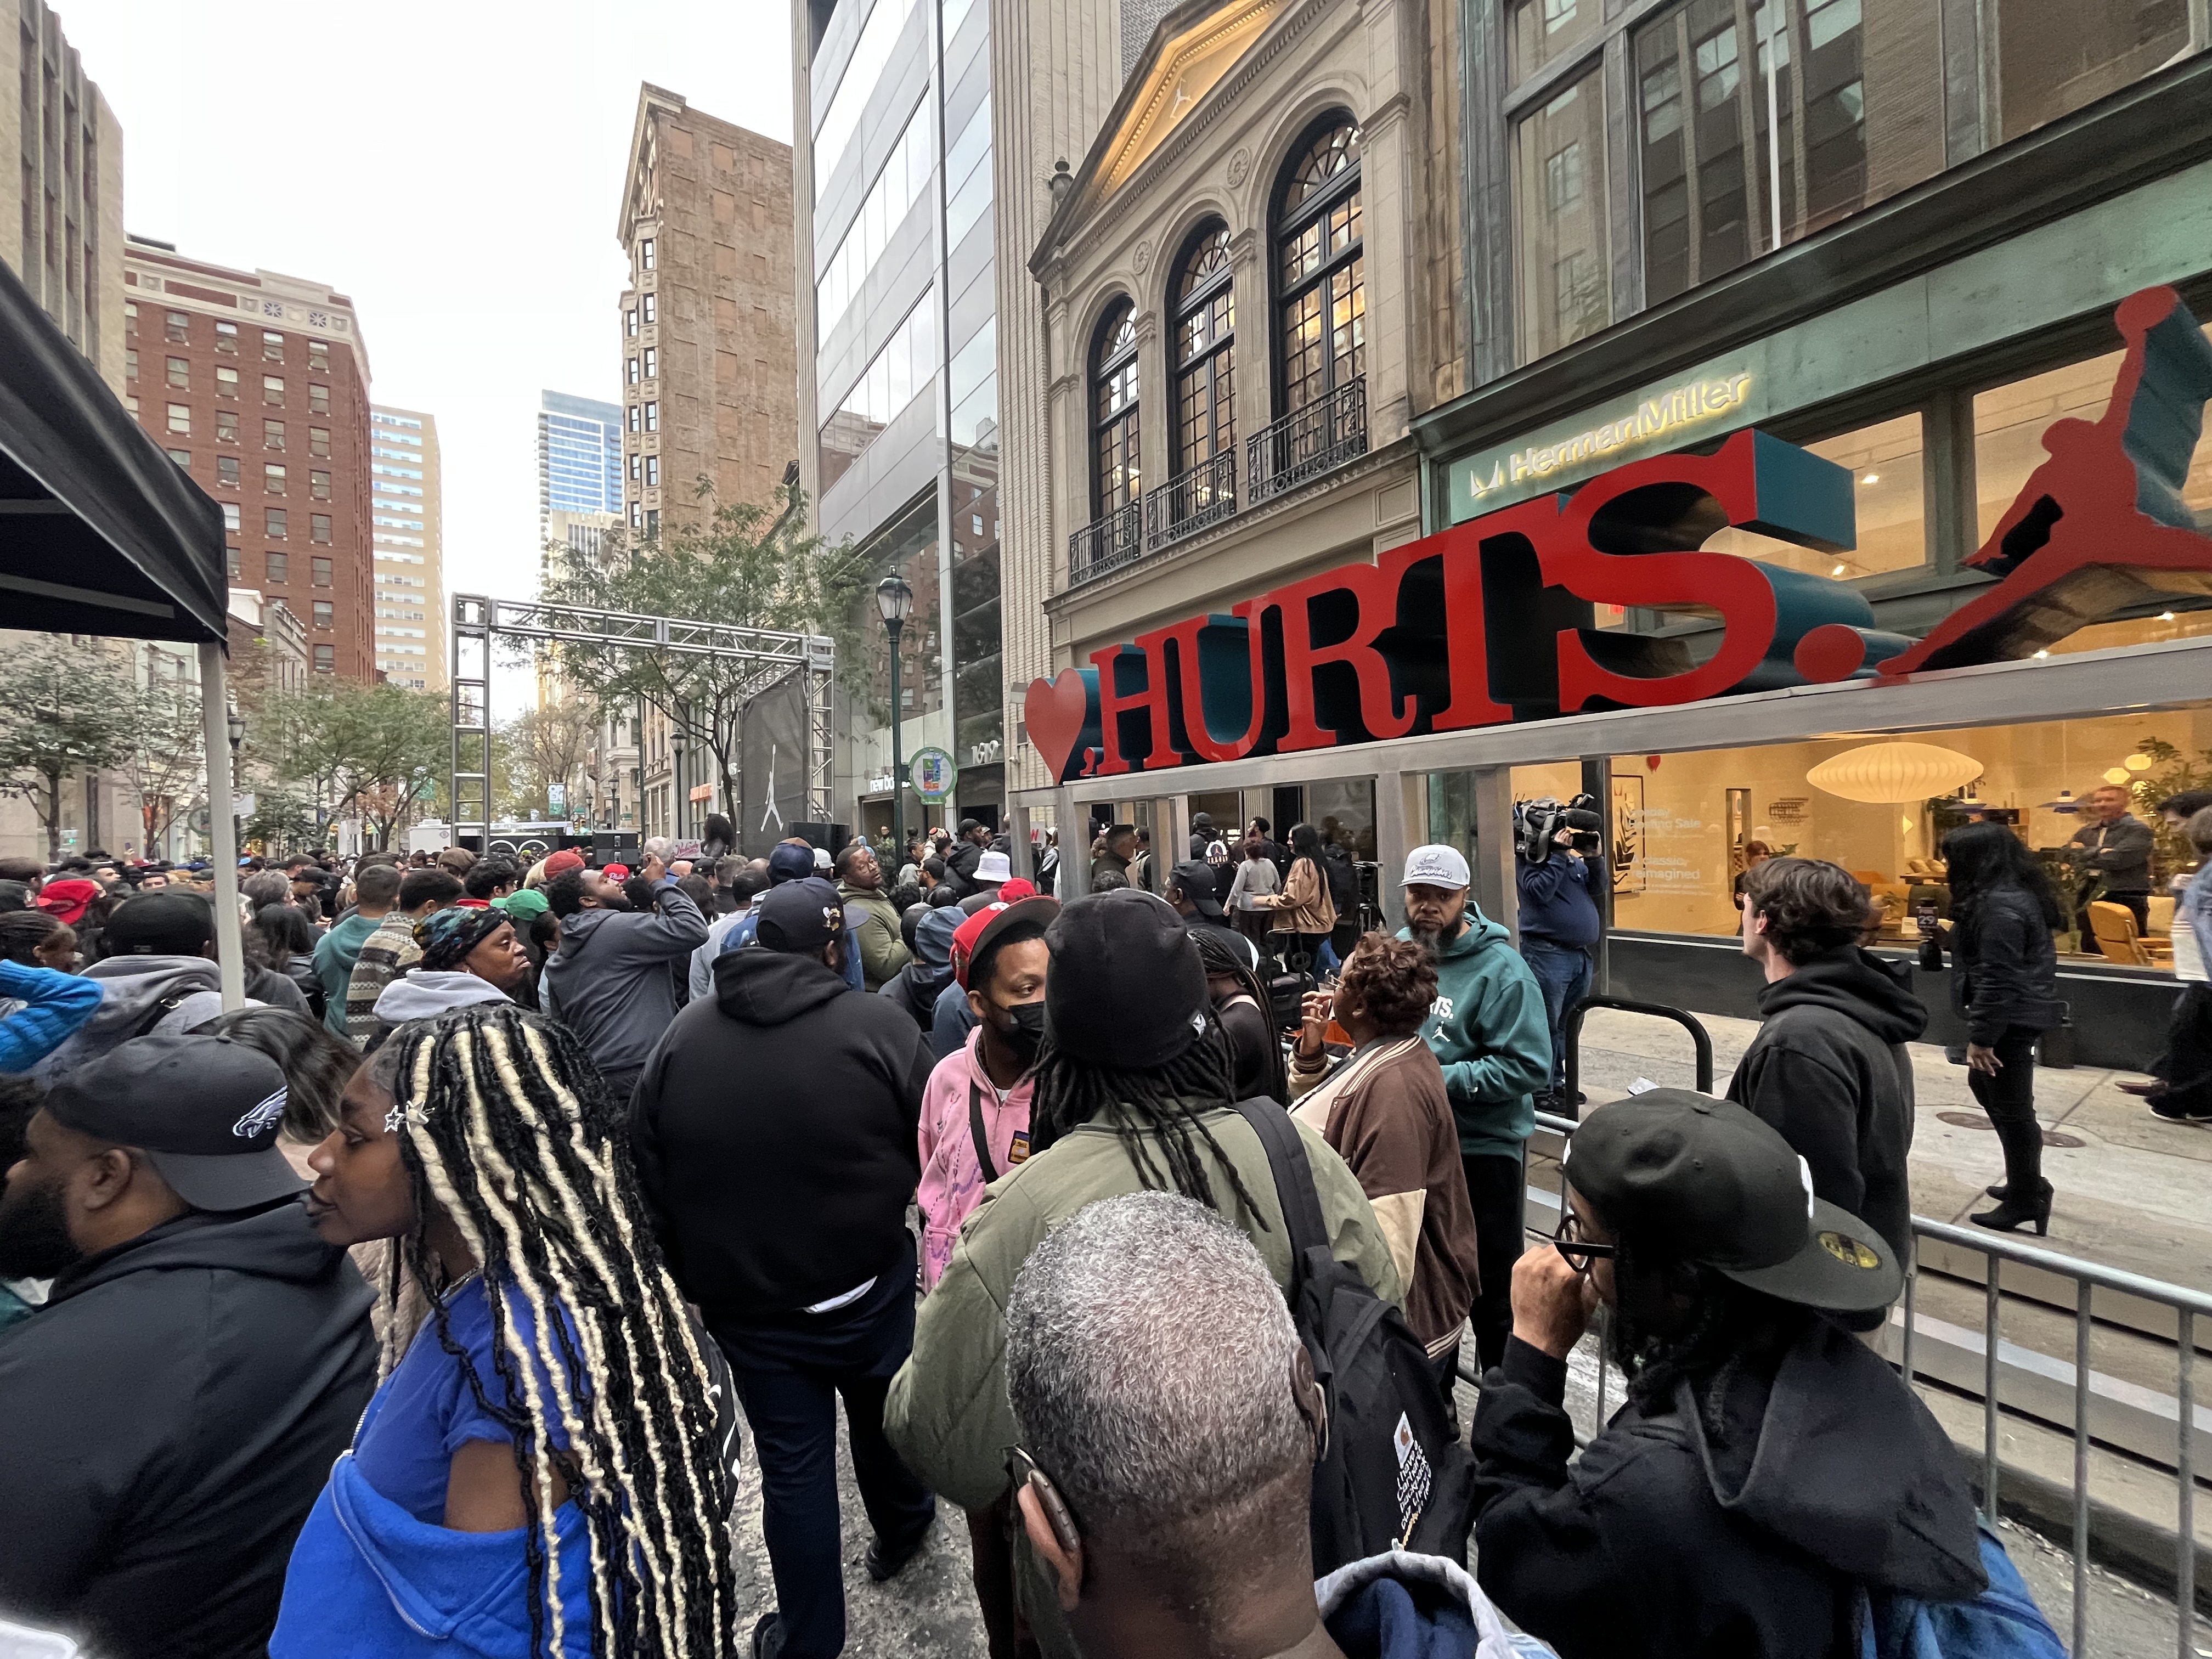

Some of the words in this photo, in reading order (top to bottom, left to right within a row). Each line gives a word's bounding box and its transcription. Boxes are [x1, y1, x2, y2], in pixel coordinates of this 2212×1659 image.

[1510, 373, 1749, 482] HermanMiller
[971, 740, 998, 764] 1619
[870, 778, 884, 792] new
[1675, 818, 1701, 828] Sale
[1410, 865, 1453, 879] Champions
